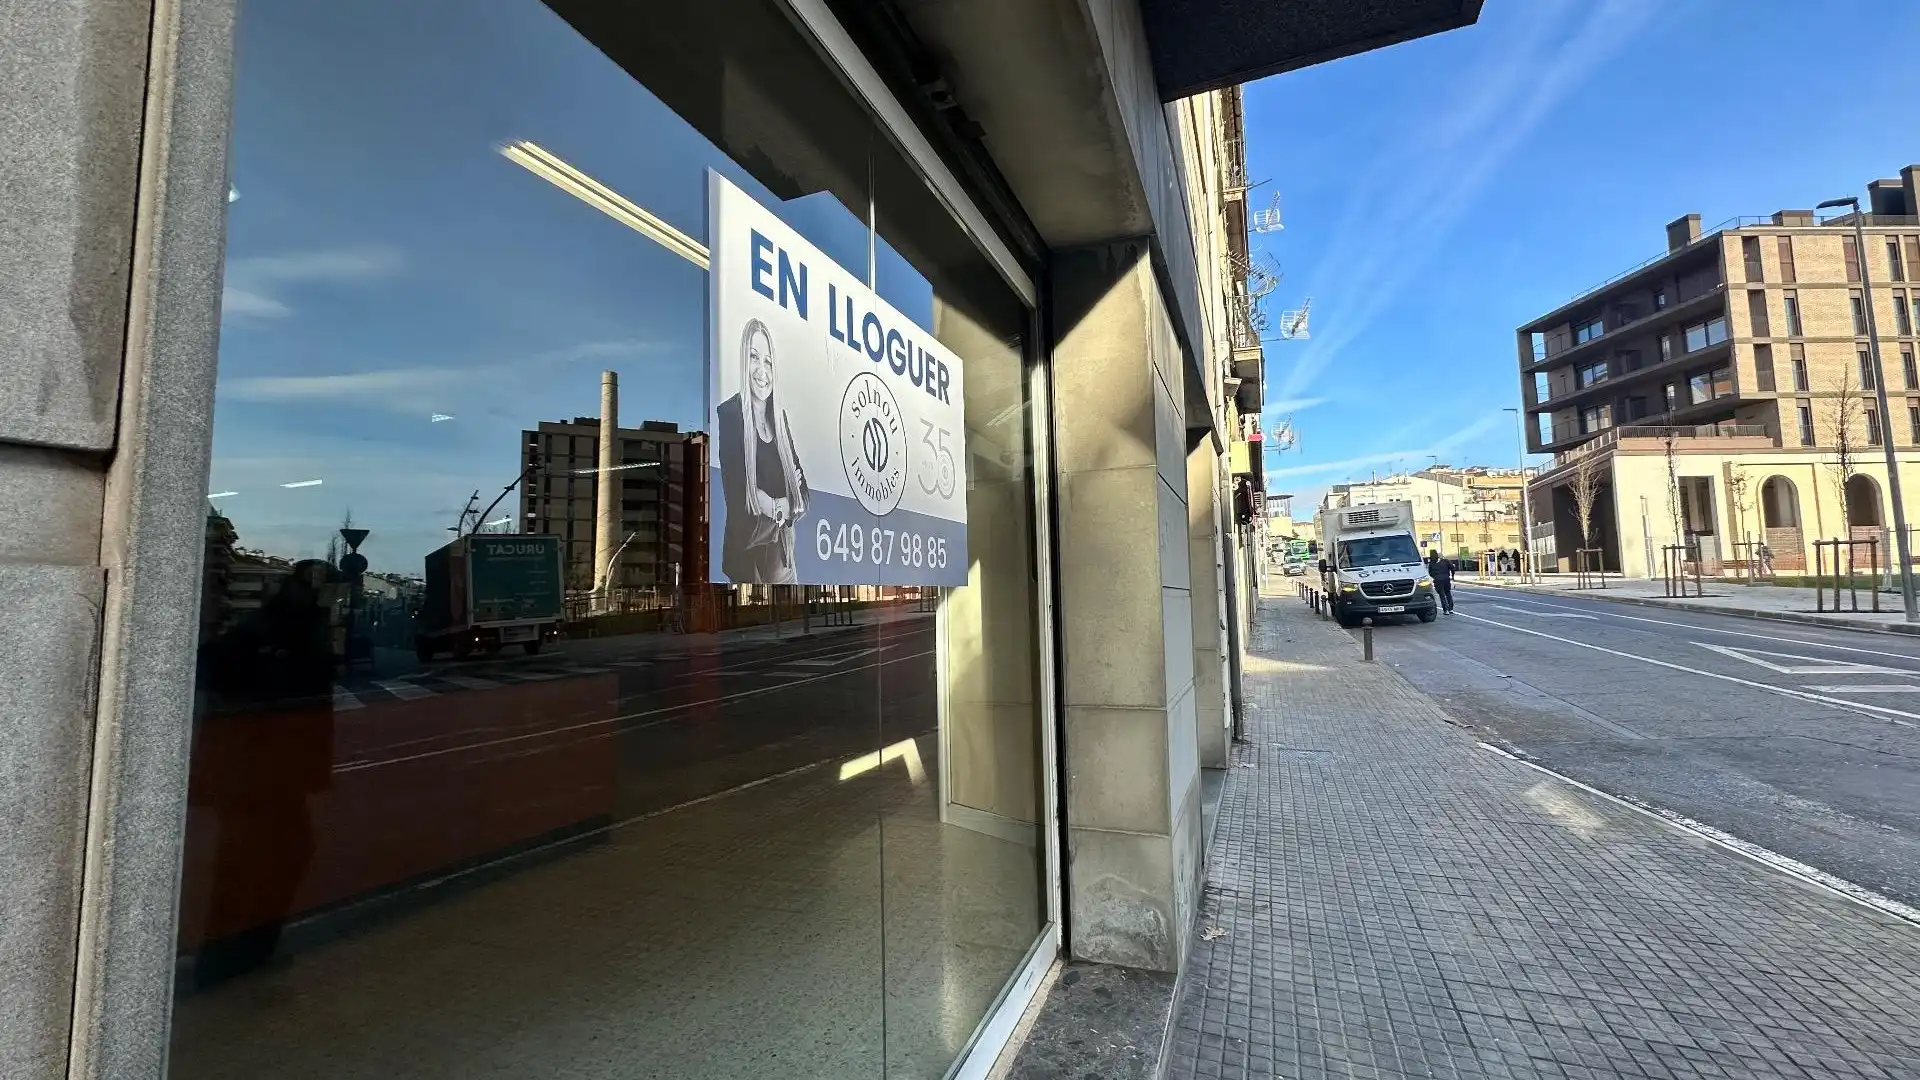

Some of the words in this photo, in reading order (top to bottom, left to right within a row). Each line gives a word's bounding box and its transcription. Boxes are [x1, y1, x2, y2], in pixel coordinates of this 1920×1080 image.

[750, 227, 808, 322] EN
[828, 282, 951, 406] LLOGUER
[851, 379, 898, 435] solnou
[851, 456, 900, 502] immobles
[918, 417, 956, 500] 35
[816, 518, 864, 563] 649
[871, 527, 895, 565] 87
[900, 531, 922, 568] 98
[927, 536, 947, 569] 85
